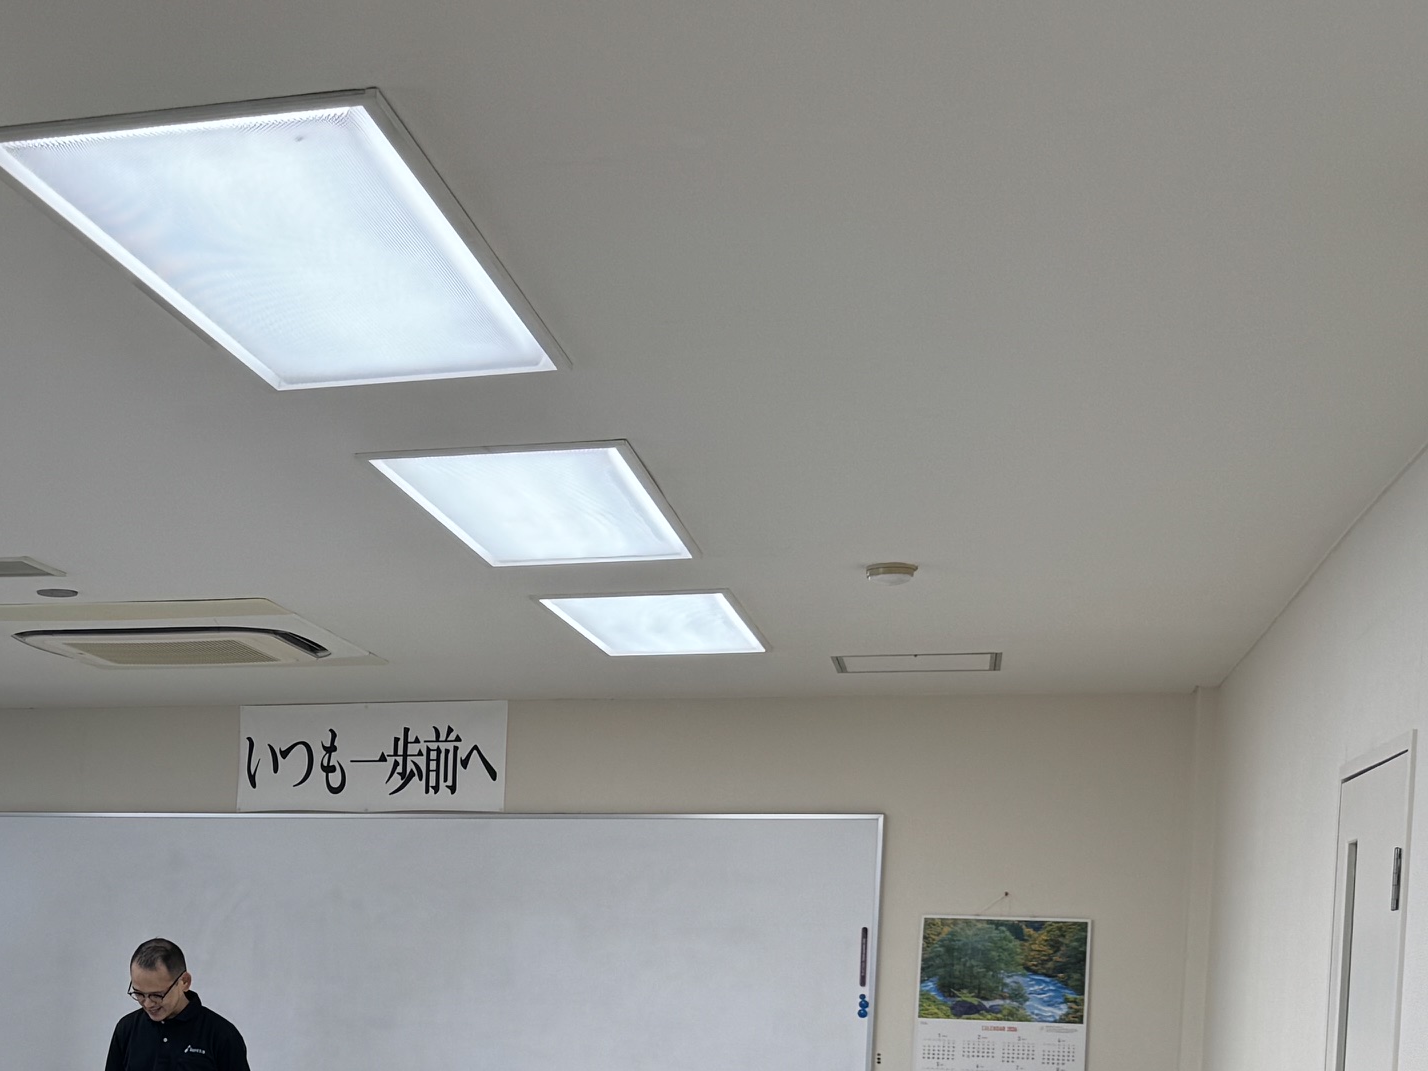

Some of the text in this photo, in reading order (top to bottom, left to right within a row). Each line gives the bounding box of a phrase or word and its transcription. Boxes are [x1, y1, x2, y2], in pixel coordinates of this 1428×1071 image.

[245, 725, 498, 795] いつも一歩前へ
